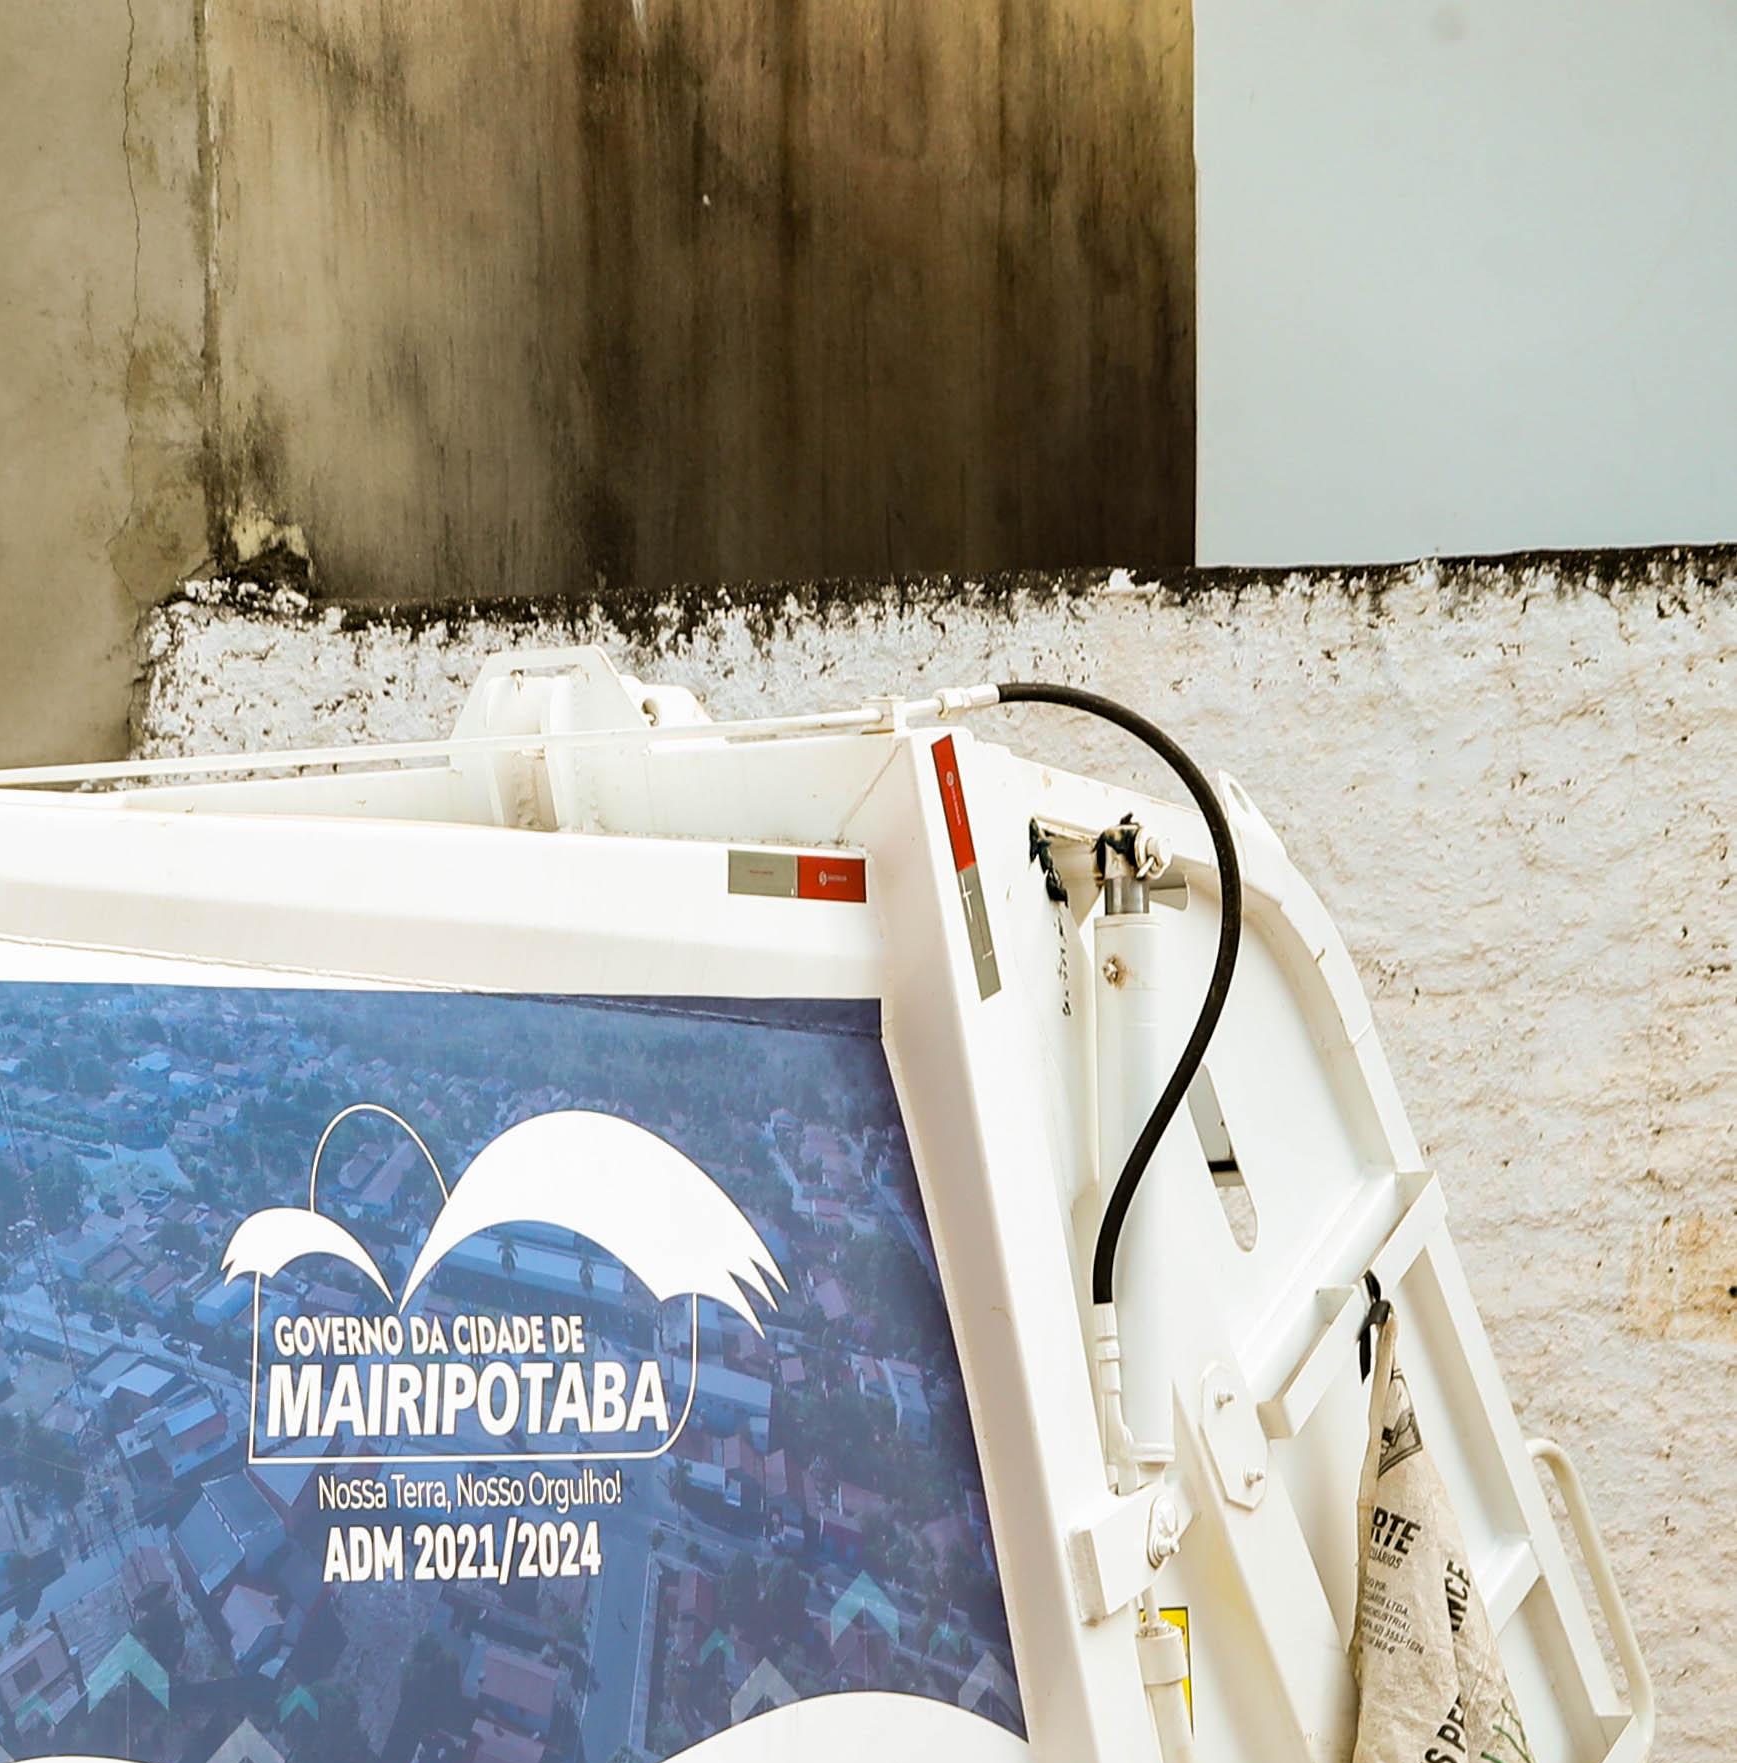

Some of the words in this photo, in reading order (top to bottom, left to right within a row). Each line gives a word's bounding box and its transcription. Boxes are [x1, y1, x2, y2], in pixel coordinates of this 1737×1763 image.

[274, 1314, 403, 1357] GOVERNO
[410, 1315, 449, 1355] DA
[452, 1315, 546, 1355] CIDADE
[551, 1315, 585, 1354] DE
[266, 1360, 670, 1439] MAIRIPOTABA
[318, 1474, 389, 1511] Nossa
[390, 1473, 453, 1515] Terra,
[456, 1472, 526, 1509] Nosso
[528, 1469, 623, 1514] Orgulho!
[323, 1523, 404, 1583] ADM
[413, 1516, 603, 1585] 2021/2024
